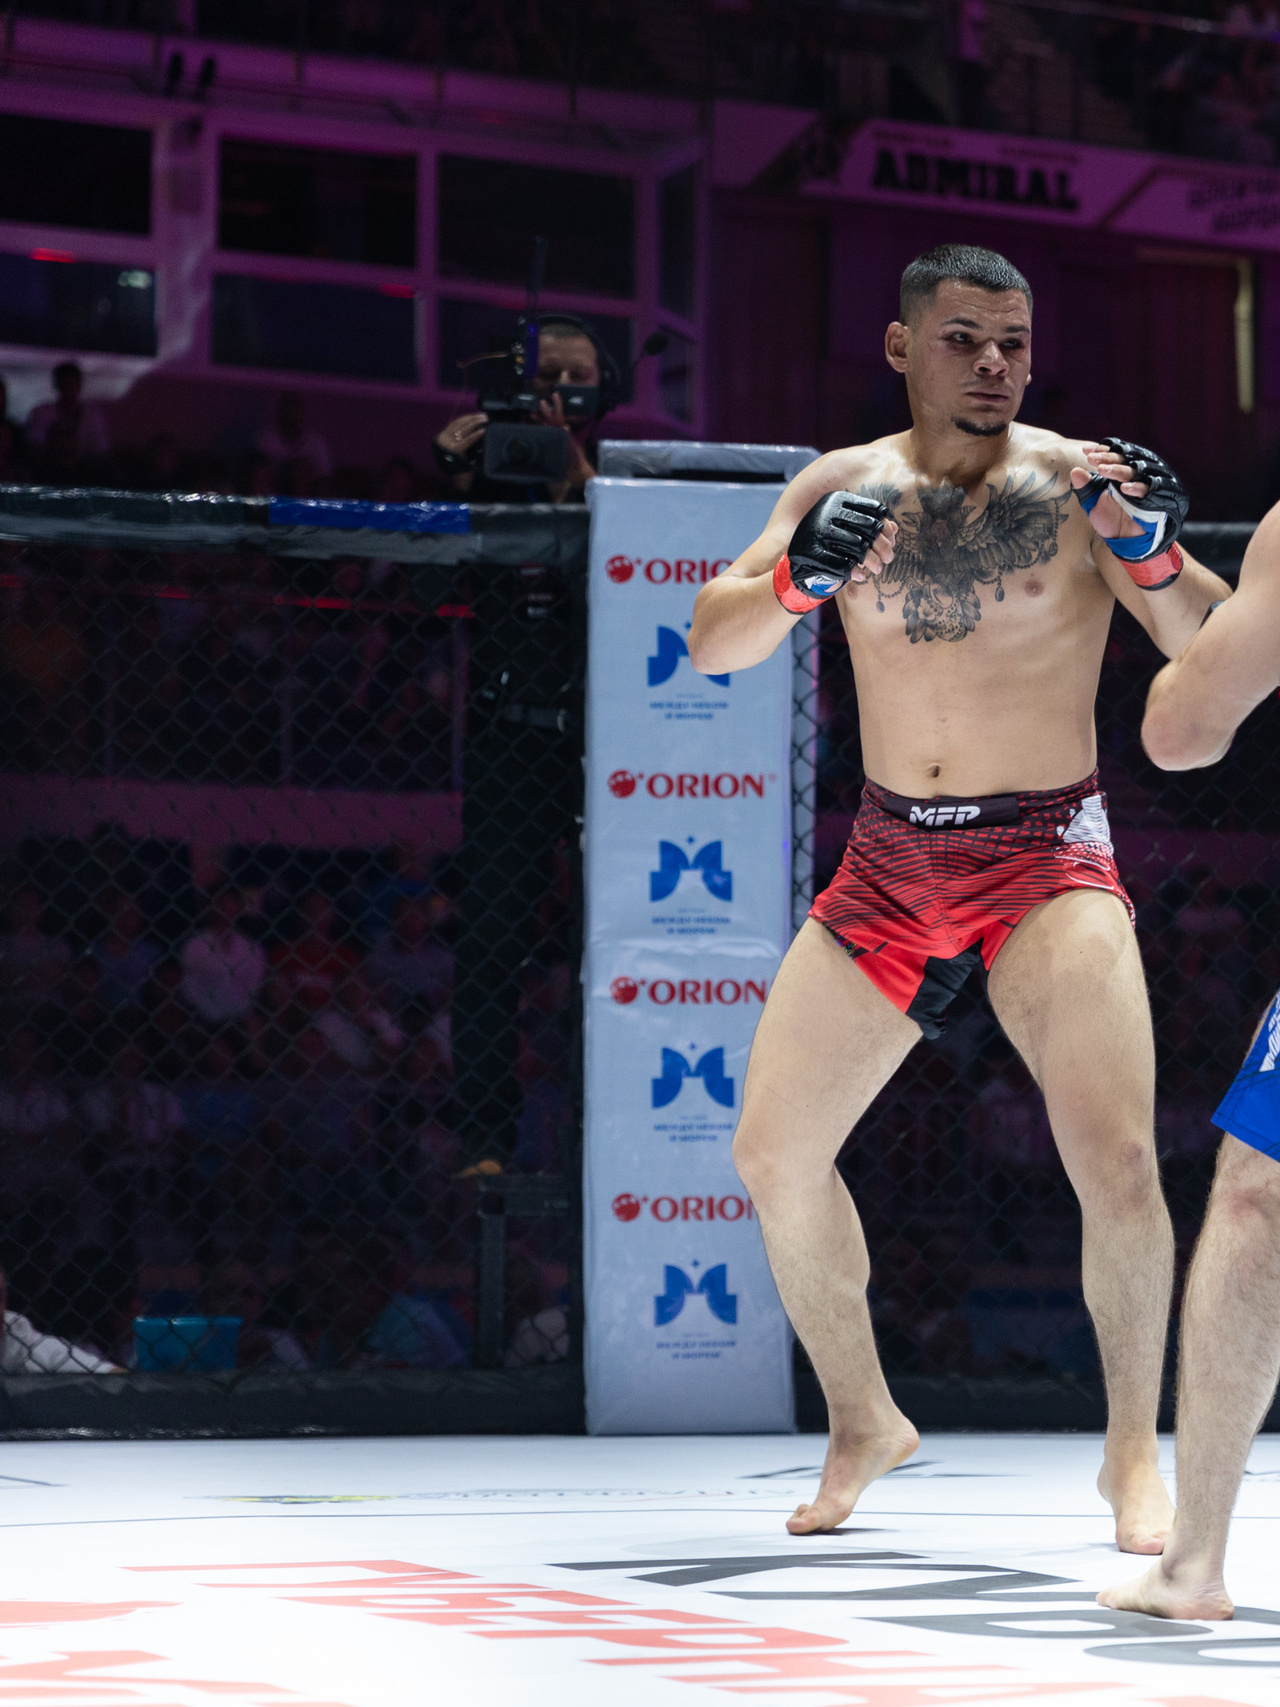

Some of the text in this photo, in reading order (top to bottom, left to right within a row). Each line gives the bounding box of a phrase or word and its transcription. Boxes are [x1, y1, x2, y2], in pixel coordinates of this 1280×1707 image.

[872, 147, 1081, 211] ADMIRAL
[646, 773, 764, 799] ORION
[909, 805, 981, 826] MFP
[648, 979, 767, 1005] ORION
[118, 1559, 1262, 1707] ГУБЕРНА
